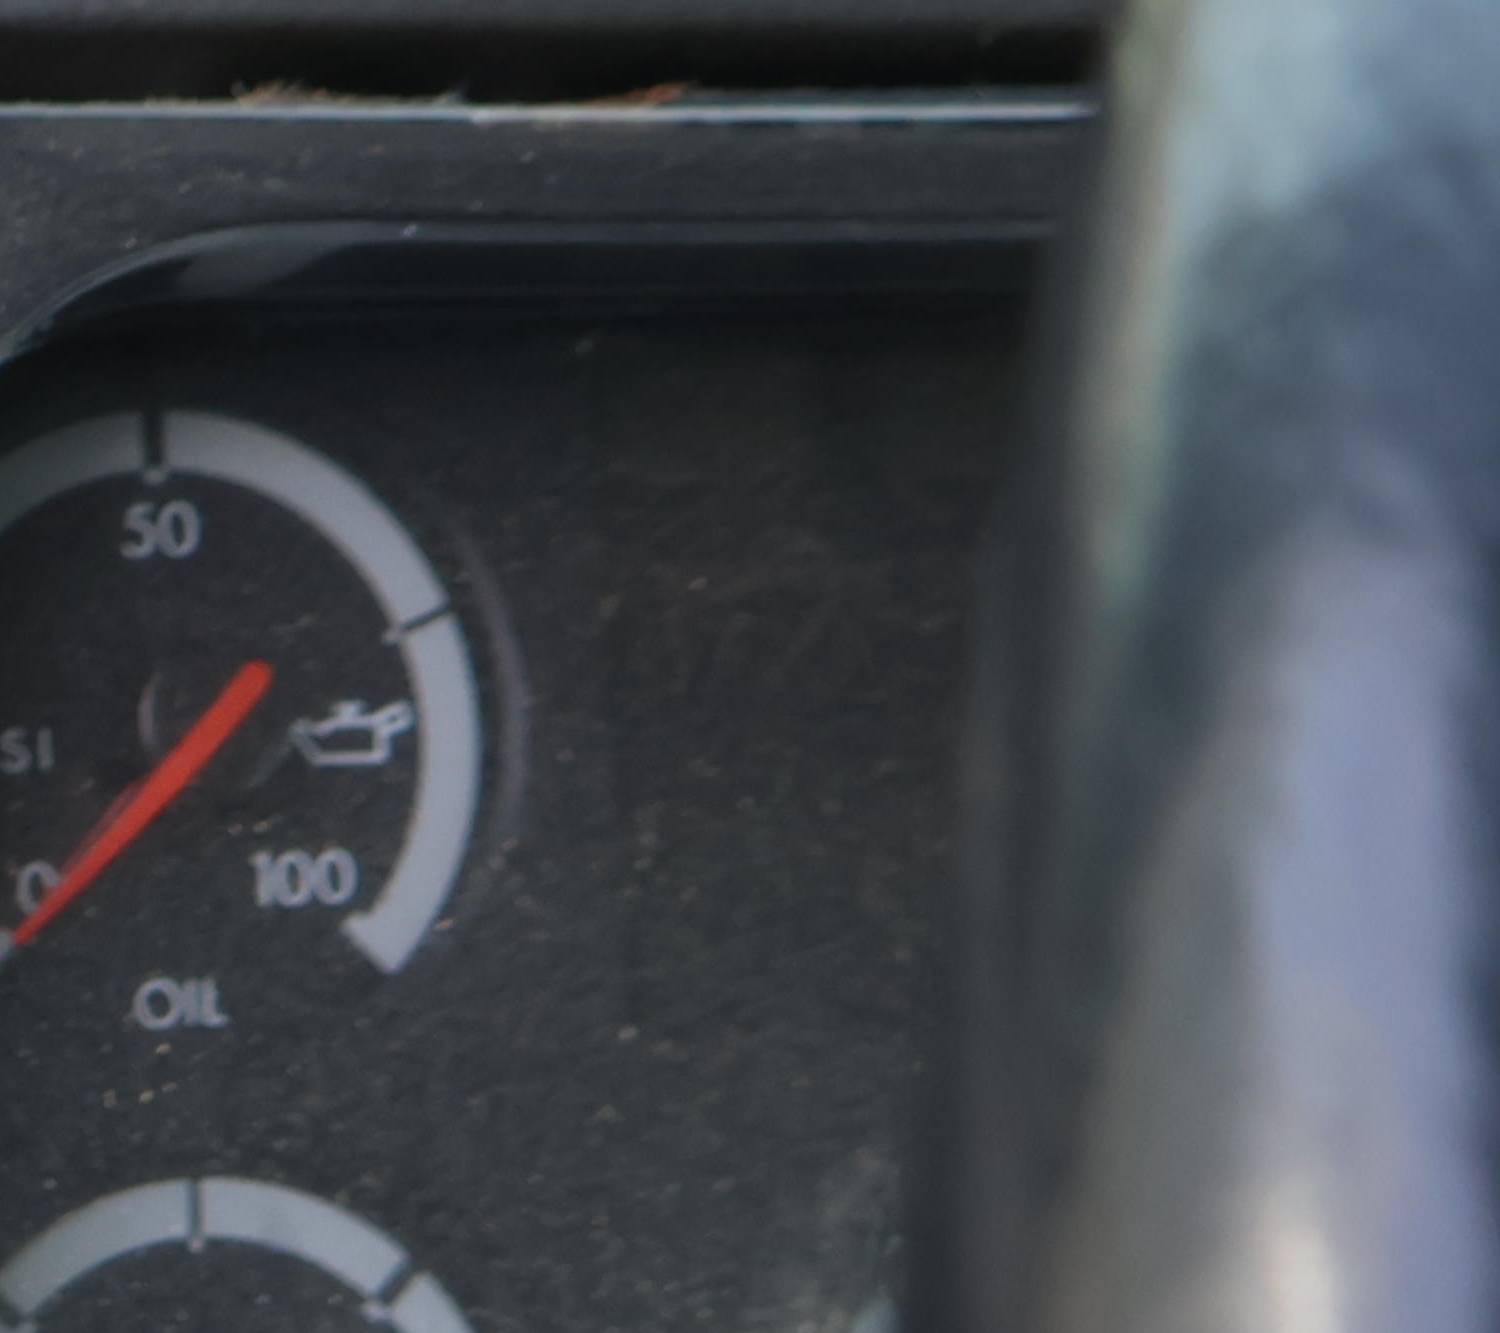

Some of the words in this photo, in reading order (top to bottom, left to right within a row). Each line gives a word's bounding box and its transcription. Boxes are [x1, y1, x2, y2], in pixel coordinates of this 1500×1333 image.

[119, 501, 201, 560] 50
[252, 847, 358, 908] 100
[131, 976, 231, 1031] OIL
